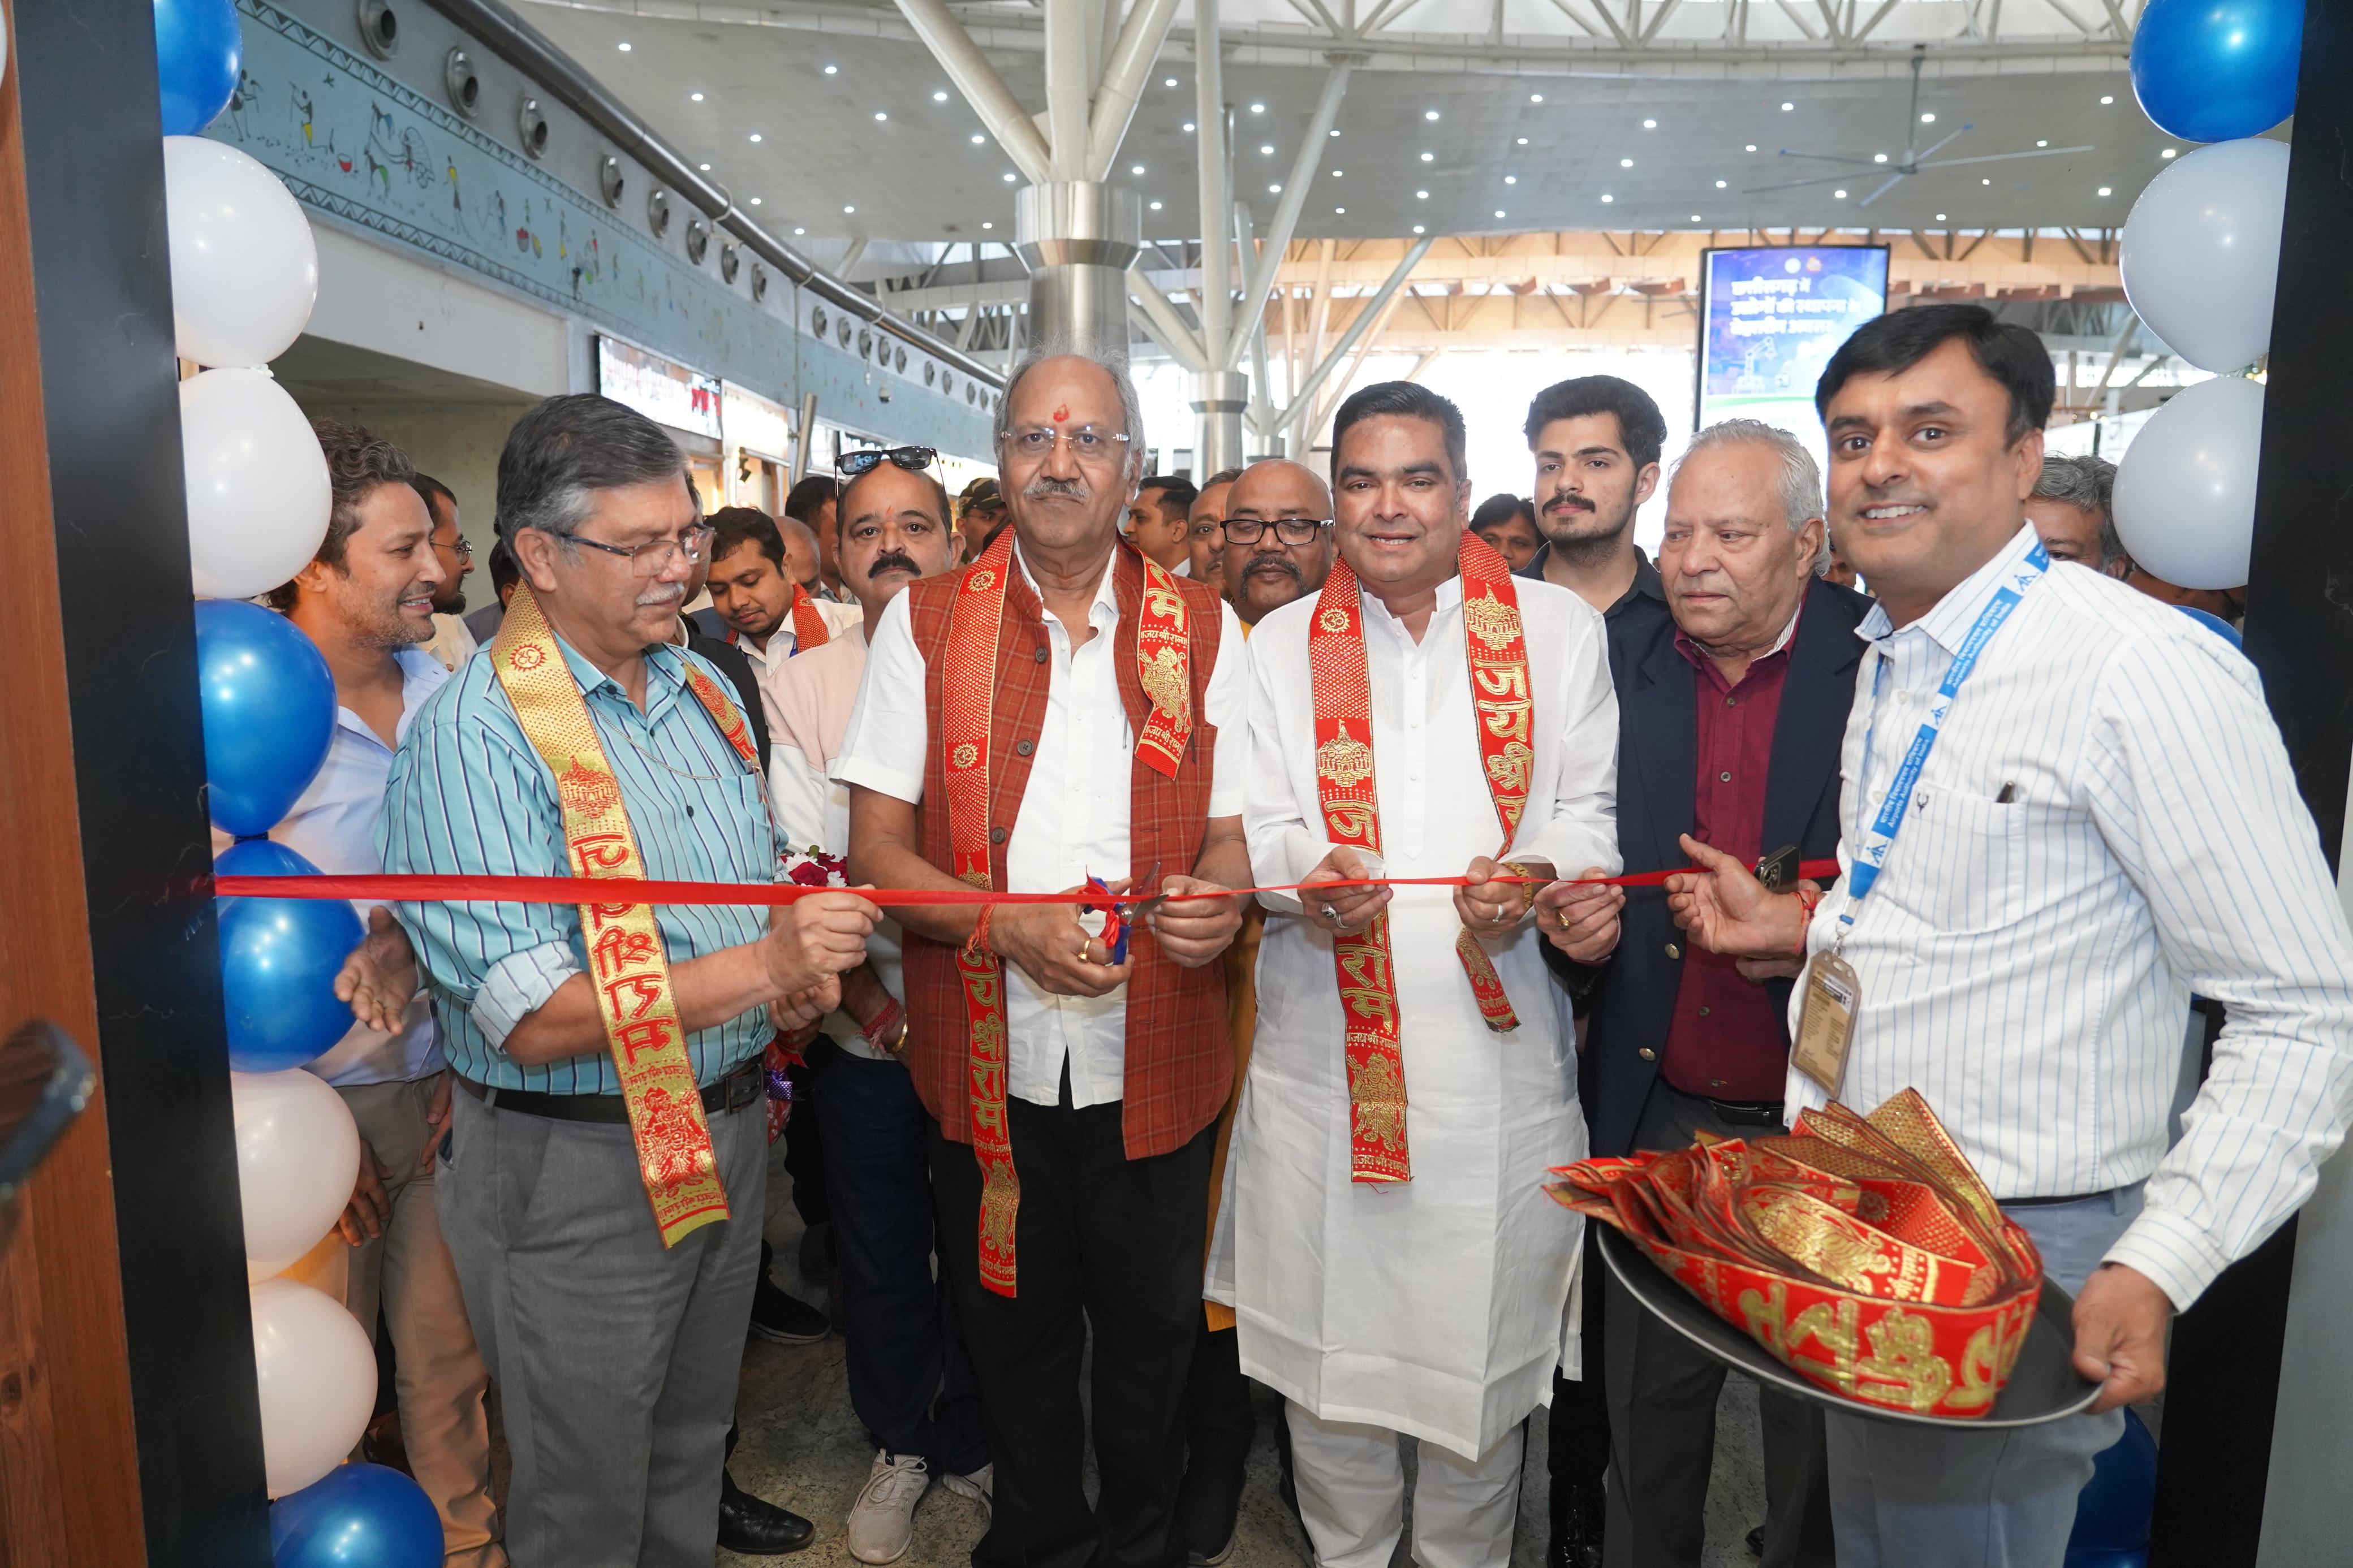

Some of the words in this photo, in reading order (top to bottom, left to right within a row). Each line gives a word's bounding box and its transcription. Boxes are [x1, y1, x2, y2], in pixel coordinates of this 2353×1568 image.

[1968, 627, 1993, 659] Authority
[1990, 618, 1998, 627] of
[1996, 603, 2012, 619] India
[1915, 757, 1922, 766] of
[1917, 739, 1929, 757] India
[1900, 766, 1918, 799] Authority
[1887, 800, 1904, 828] Airports
[972, 1013, 1005, 1061] श्री
[971, 1056, 1005, 1140] राम
